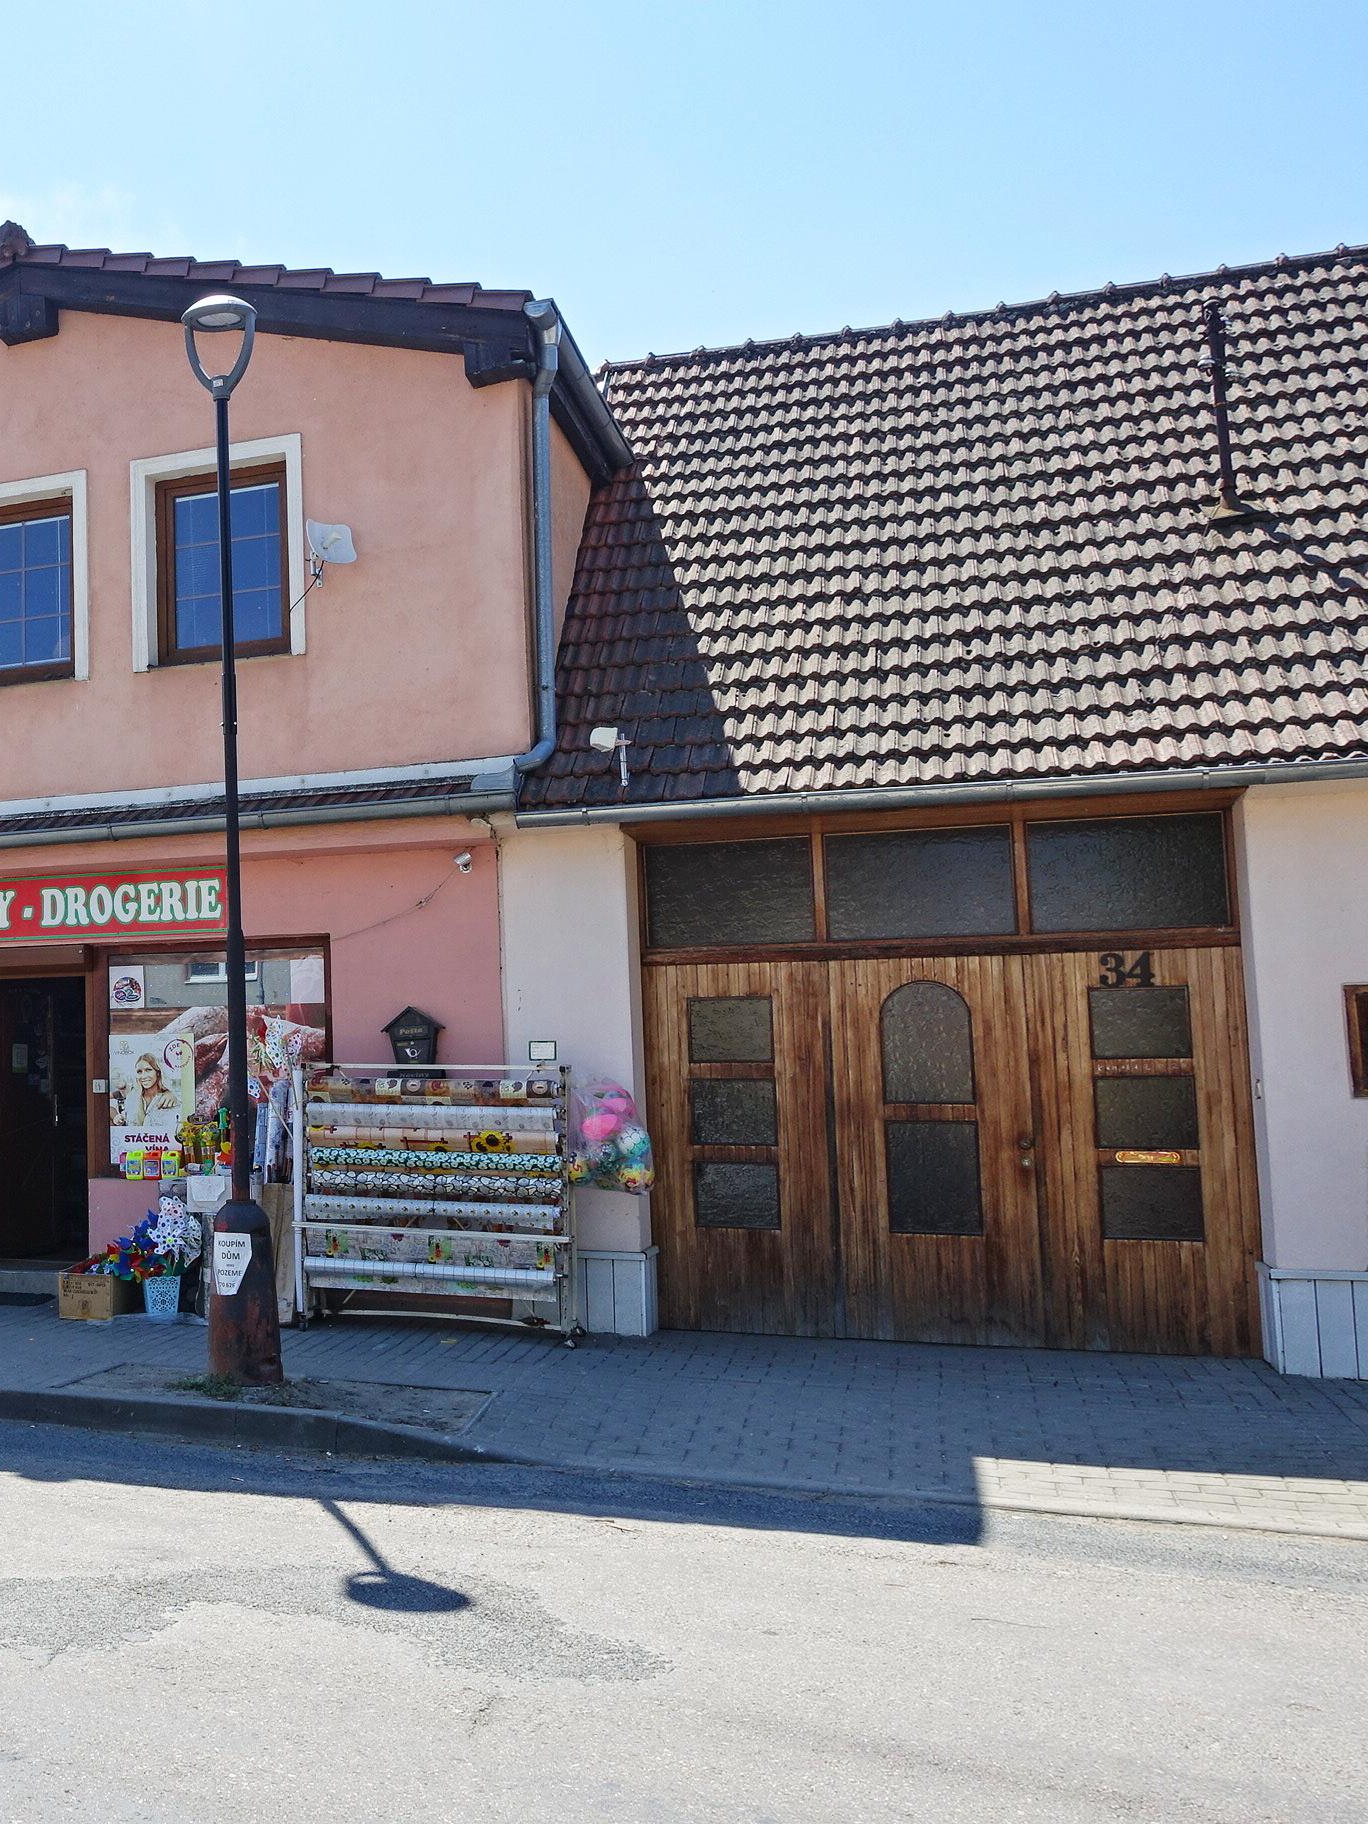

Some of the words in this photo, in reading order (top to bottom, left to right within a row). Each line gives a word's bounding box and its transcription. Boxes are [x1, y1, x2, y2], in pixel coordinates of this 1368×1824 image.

[40, 878, 222, 927] DROGERIE
[1099, 951, 1156, 988] 34
[124, 1133, 170, 1143] STÁČENÁ
[218, 1240, 246, 1248] KOUPÍM
[221, 1250, 241, 1260] DŮM
